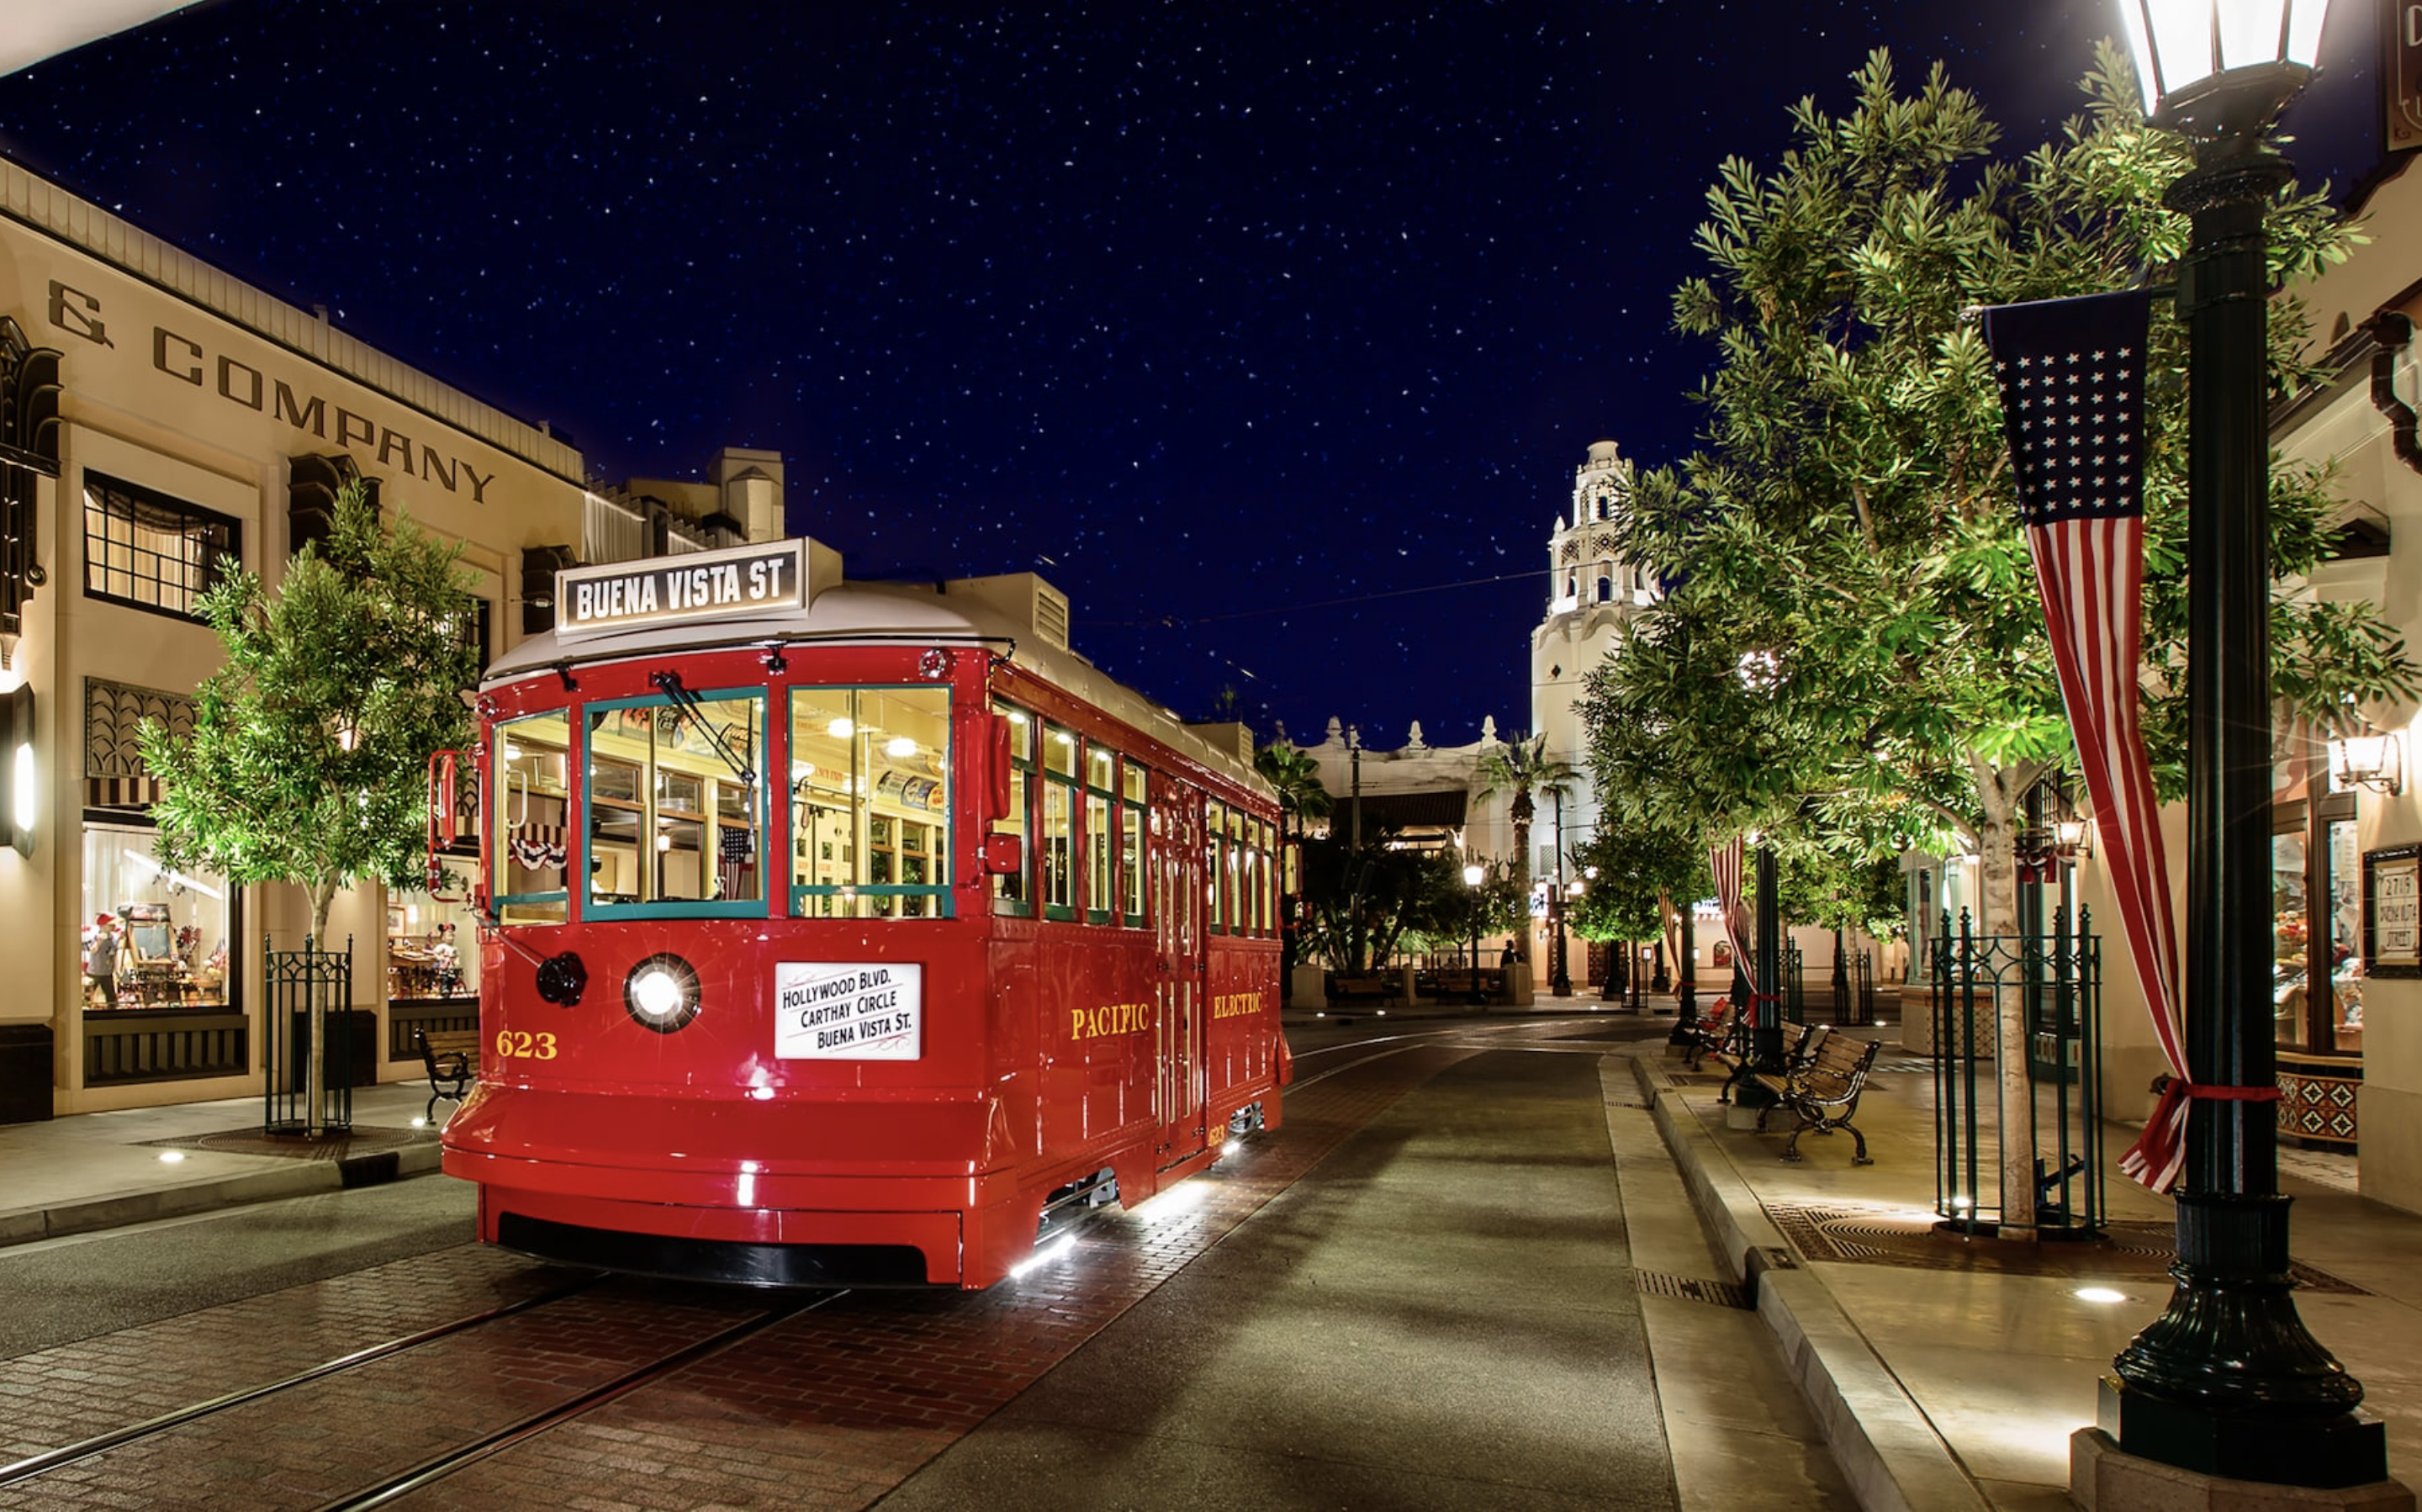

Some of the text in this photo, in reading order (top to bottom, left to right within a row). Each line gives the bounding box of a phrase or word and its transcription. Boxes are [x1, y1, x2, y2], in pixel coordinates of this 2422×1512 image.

[49, 279, 494, 504] & COMPANY
[577, 558, 784, 621] BUENA VISTA ST
[783, 969, 891, 1009] HOLLYWOOD BLVD.
[801, 991, 896, 1028] CARTHAY CIRCLE
[1071, 992, 1262, 1040] PACIFIC ELECTRIC
[496, 1030, 558, 1060] 623
[817, 1013, 912, 1049] BUENA VISTA ST.
[1208, 1124, 1225, 1147] 623
